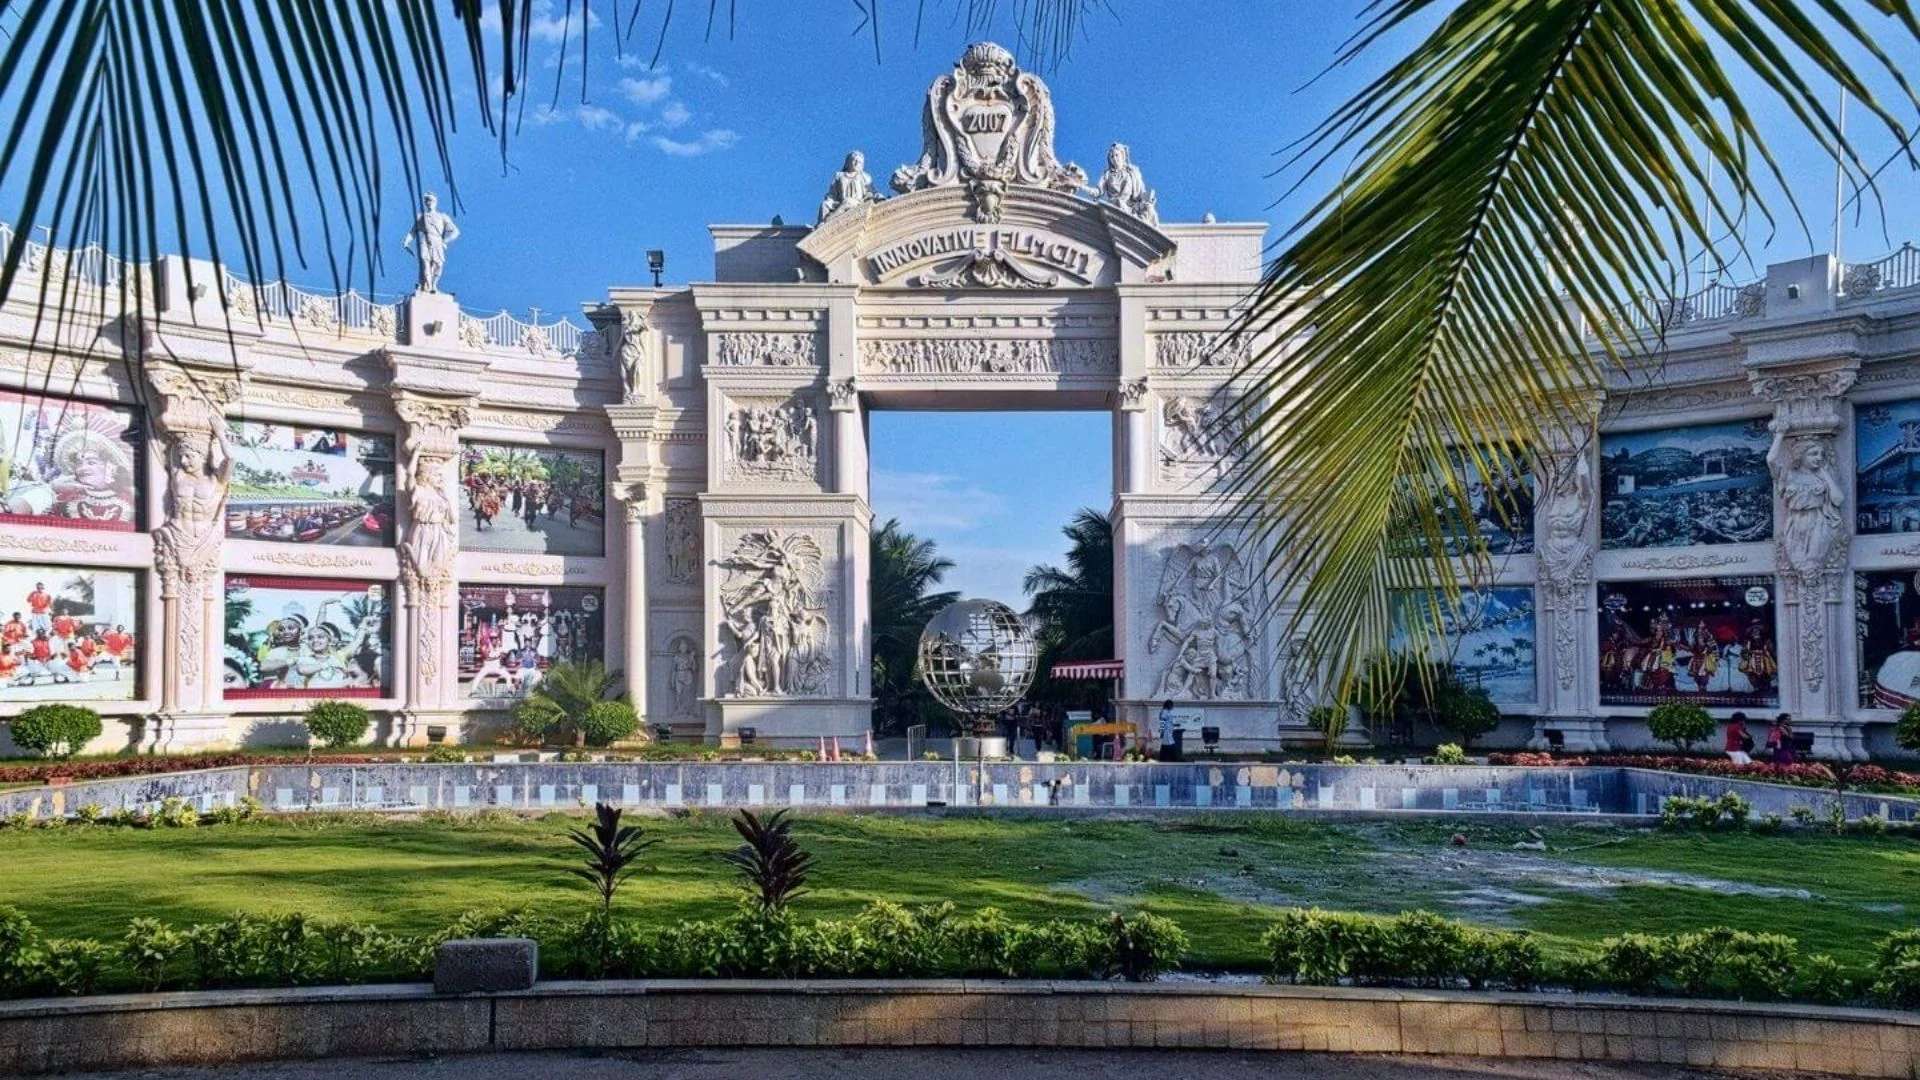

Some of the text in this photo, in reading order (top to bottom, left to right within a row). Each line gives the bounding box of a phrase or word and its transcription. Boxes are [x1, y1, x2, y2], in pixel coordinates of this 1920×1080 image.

[965, 112, 1006, 132] 2007
[873, 230, 986, 274] INNOVATIVE
[996, 230, 1045, 258] FILM
